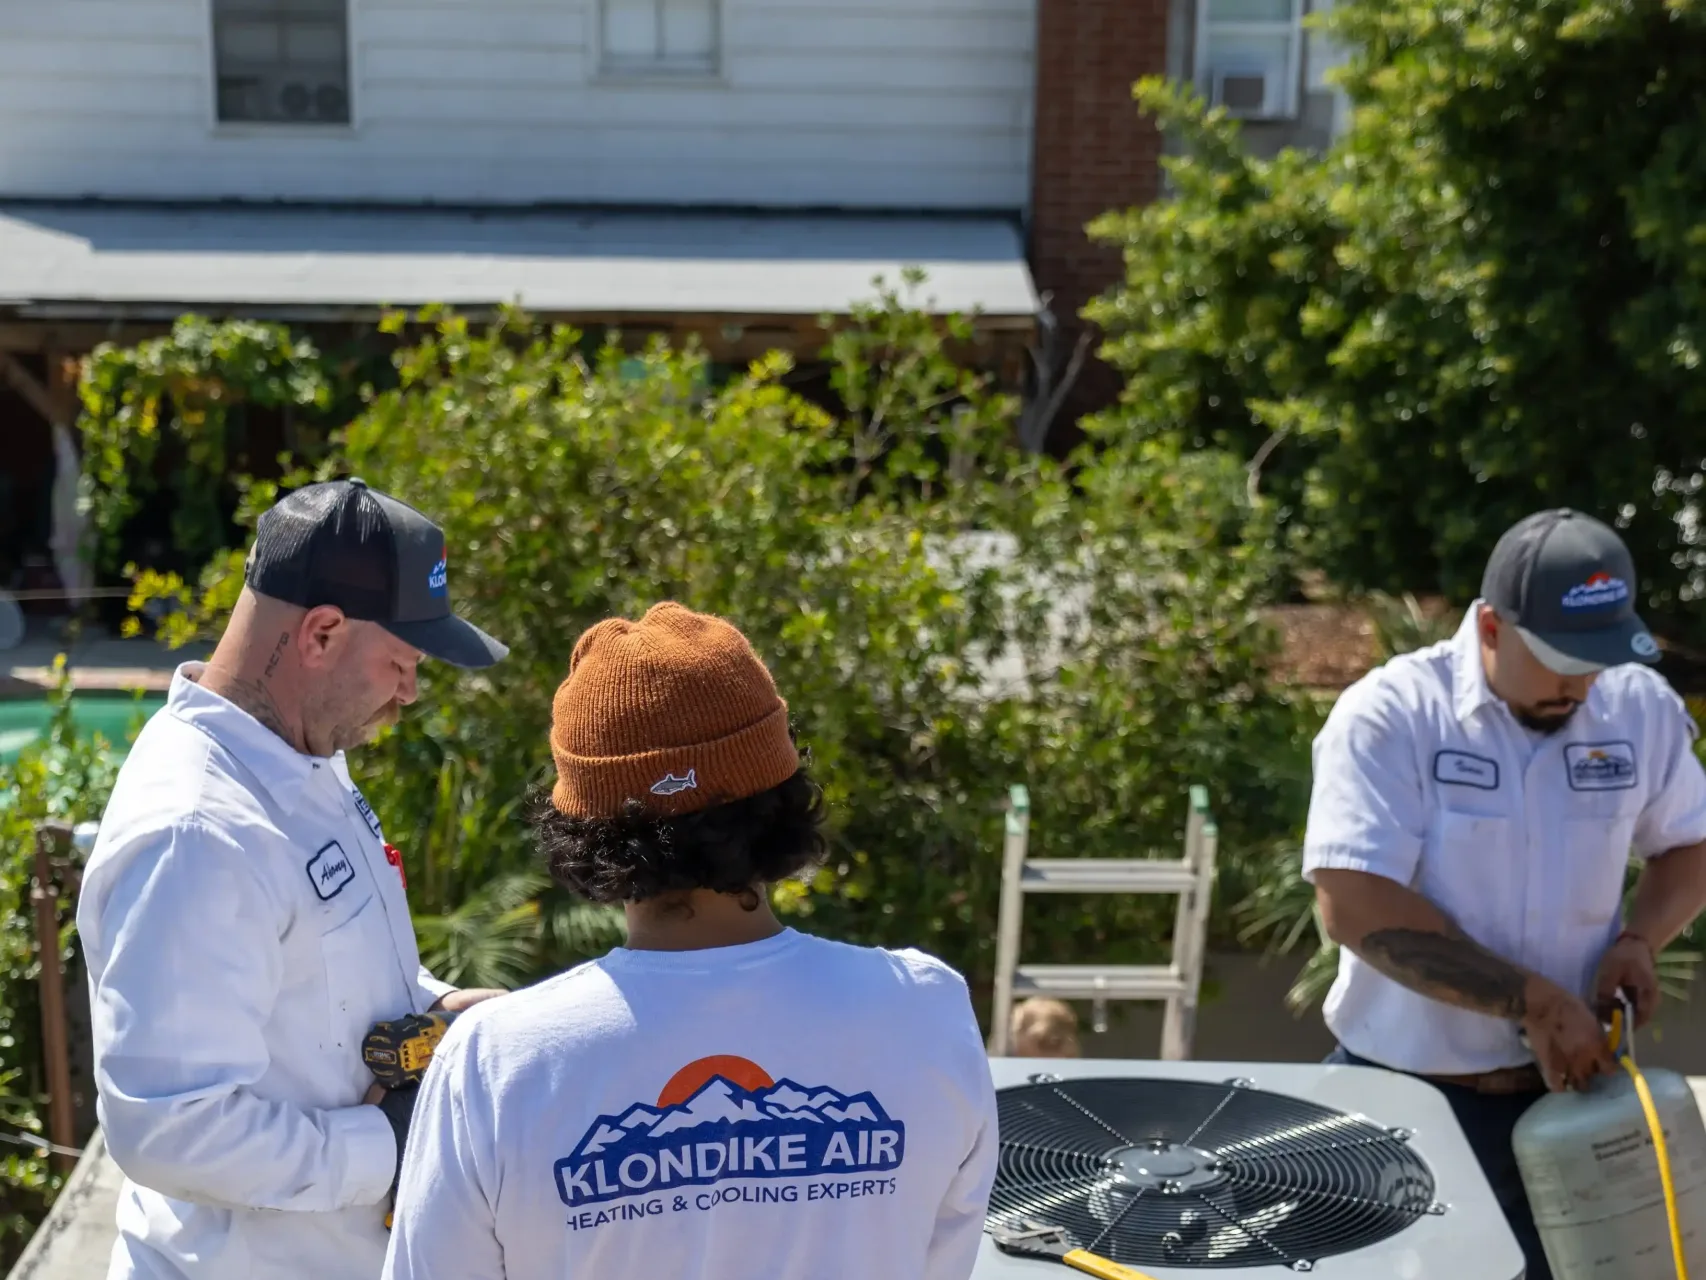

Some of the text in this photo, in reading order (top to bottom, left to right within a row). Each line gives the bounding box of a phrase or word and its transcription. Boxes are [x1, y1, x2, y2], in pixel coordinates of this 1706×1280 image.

[561, 1129, 900, 1201] KLONDIKE AIR
[567, 1177, 897, 1231] HEATING & COOLING EXPERTS
